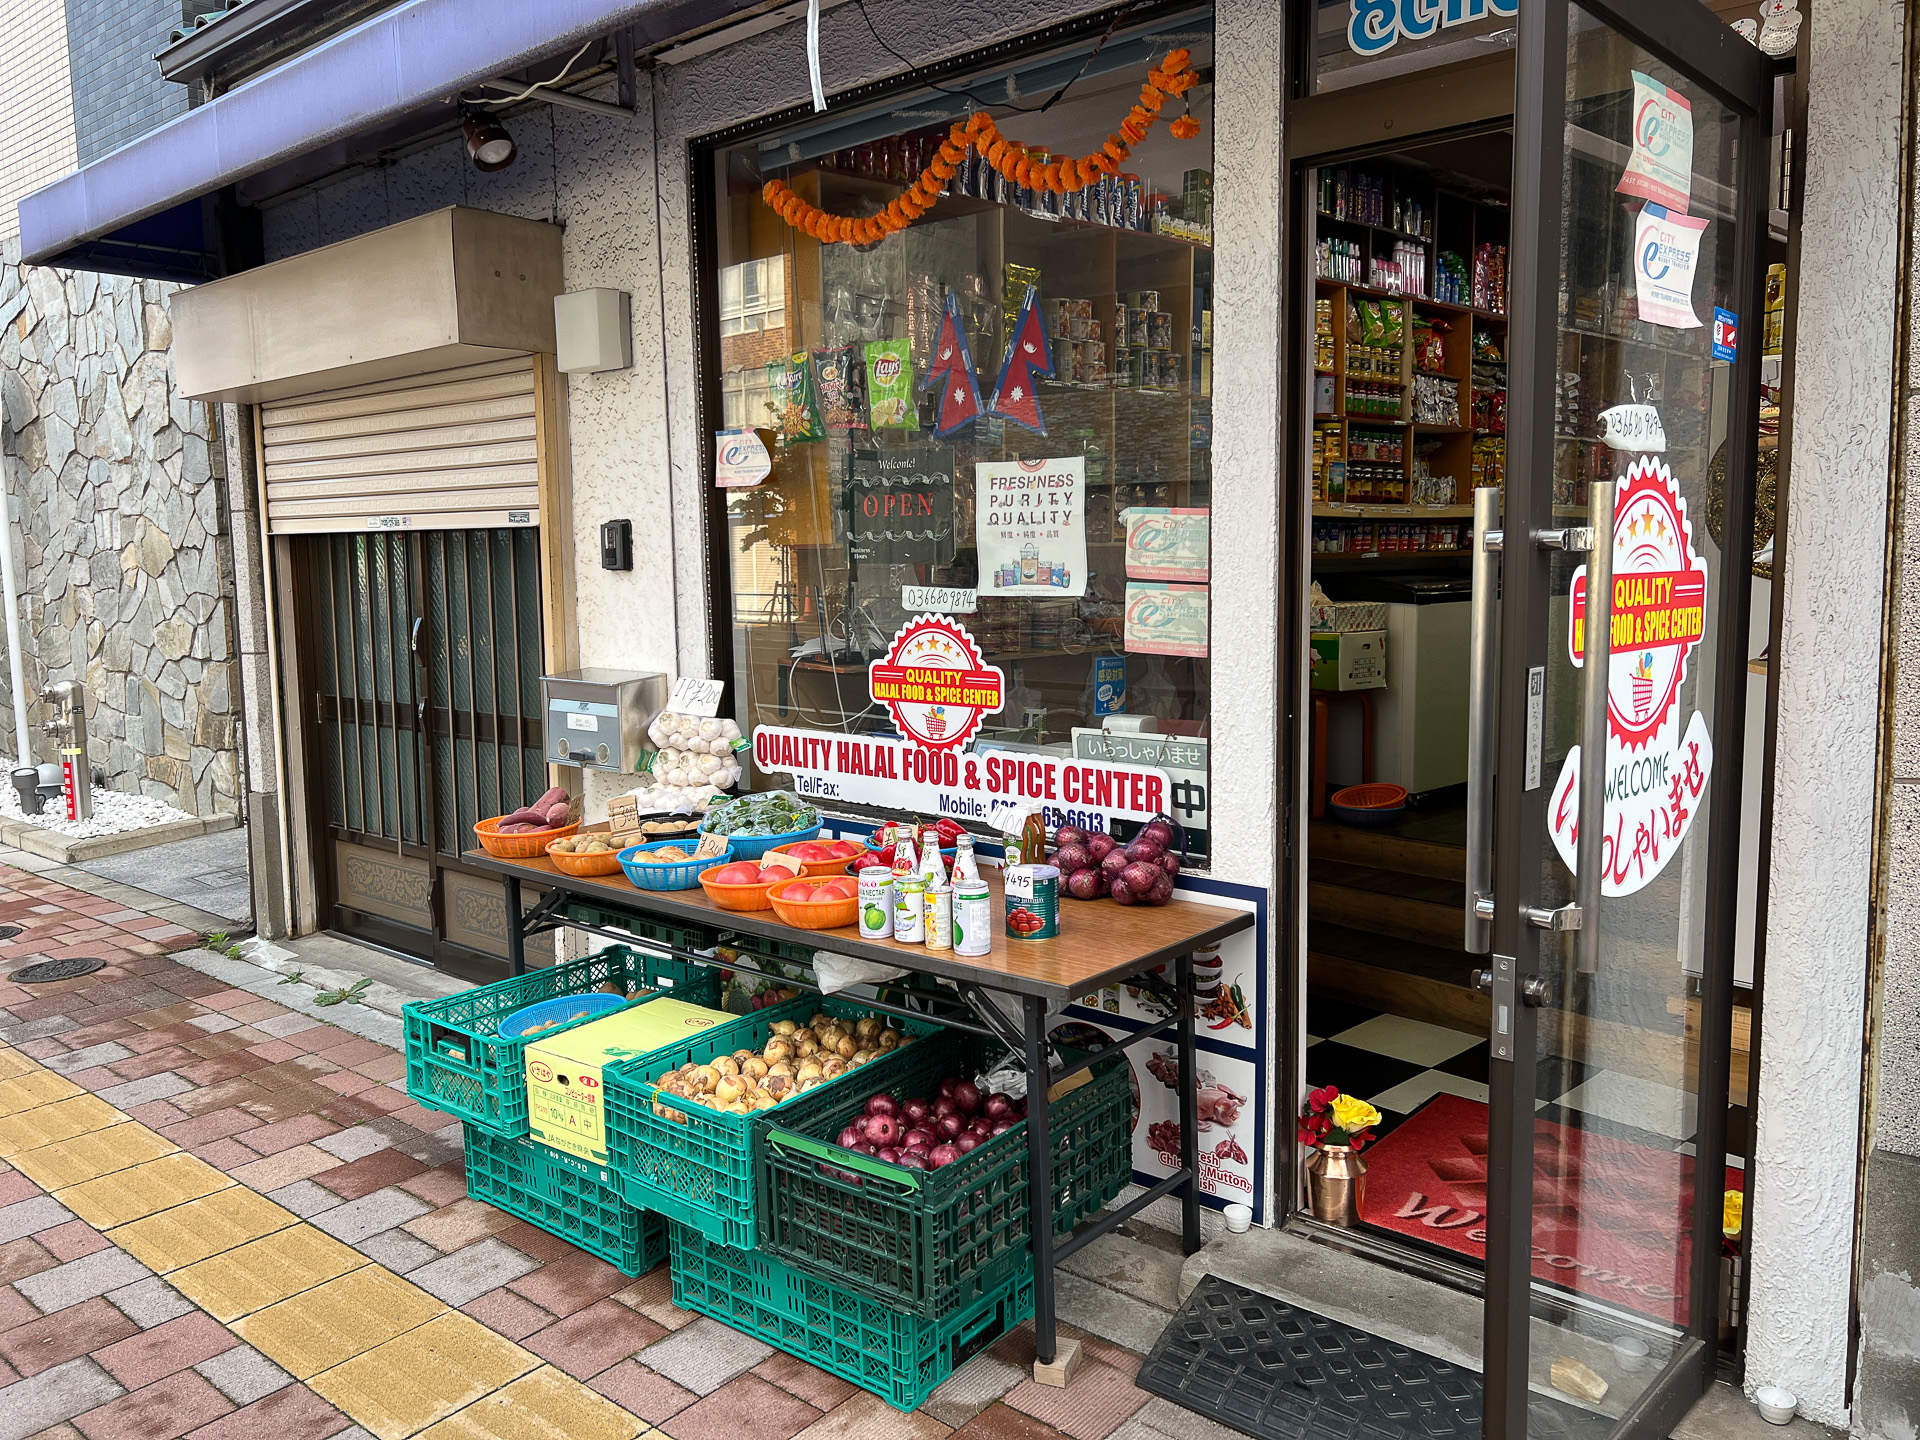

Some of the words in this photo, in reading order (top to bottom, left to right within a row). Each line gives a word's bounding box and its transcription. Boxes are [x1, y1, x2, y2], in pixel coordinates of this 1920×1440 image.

[1661, 107, 1677, 124] CITY
[1659, 120, 1691, 145] EXPRESS
[1659, 231, 1675, 245] CITY
[1658, 243, 1692, 263] EXPRESS
[878, 457, 916, 471] Welcome!
[990, 473, 1074, 491] FRESHNESS
[863, 492, 934, 518] OPEN
[990, 491, 1073, 508] PURITY
[989, 510, 1072, 526] QUALITY
[1163, 521, 1186, 529] CITY
[1161, 529, 1209, 538] EXPRESS
[908, 588, 975, 612] 0366809894
[1161, 597, 1184, 605] CITY
[1615, 577, 1674, 609] QUALITY
[1159, 605, 1207, 614] EXPRESS
[1610, 613, 1634, 648] FOOD
[1635, 616, 1643, 643] &
[1643, 608, 1671, 641] SPICE
[1671, 606, 1702, 638] CENTER
[905, 668, 962, 686] QUALITY
[1098, 668, 1124, 682] 感染対策
[874, 682, 900, 699] HALAL
[902, 684, 925, 701] FOOD
[926, 688, 934, 702] &
[934, 686, 962, 704] SPICE
[963, 688, 999, 706] CENTER
[1088, 739, 1201, 766] いらっしゃいませ
[756, 732, 832, 771] QUALITY
[837, 741, 898, 780] HALAL
[902, 747, 958, 787] FOOD
[964, 760, 981, 790] &
[986, 756, 1057, 800] SPICE
[1063, 765, 1163, 813] CENTER
[1605, 751, 1669, 803] WELCOME
[797, 774, 840, 797] Tel/Fax:
[939, 793, 987, 818] Mobile:
[1171, 779, 1206, 819] 中
[569, 1115, 577, 1127] A
[583, 1118, 592, 1131] 中
[1198, 1151, 1219, 1167] resh
[1199, 1179, 1215, 1193] ish
[1206, 1166, 1251, 1192] Mutton,
